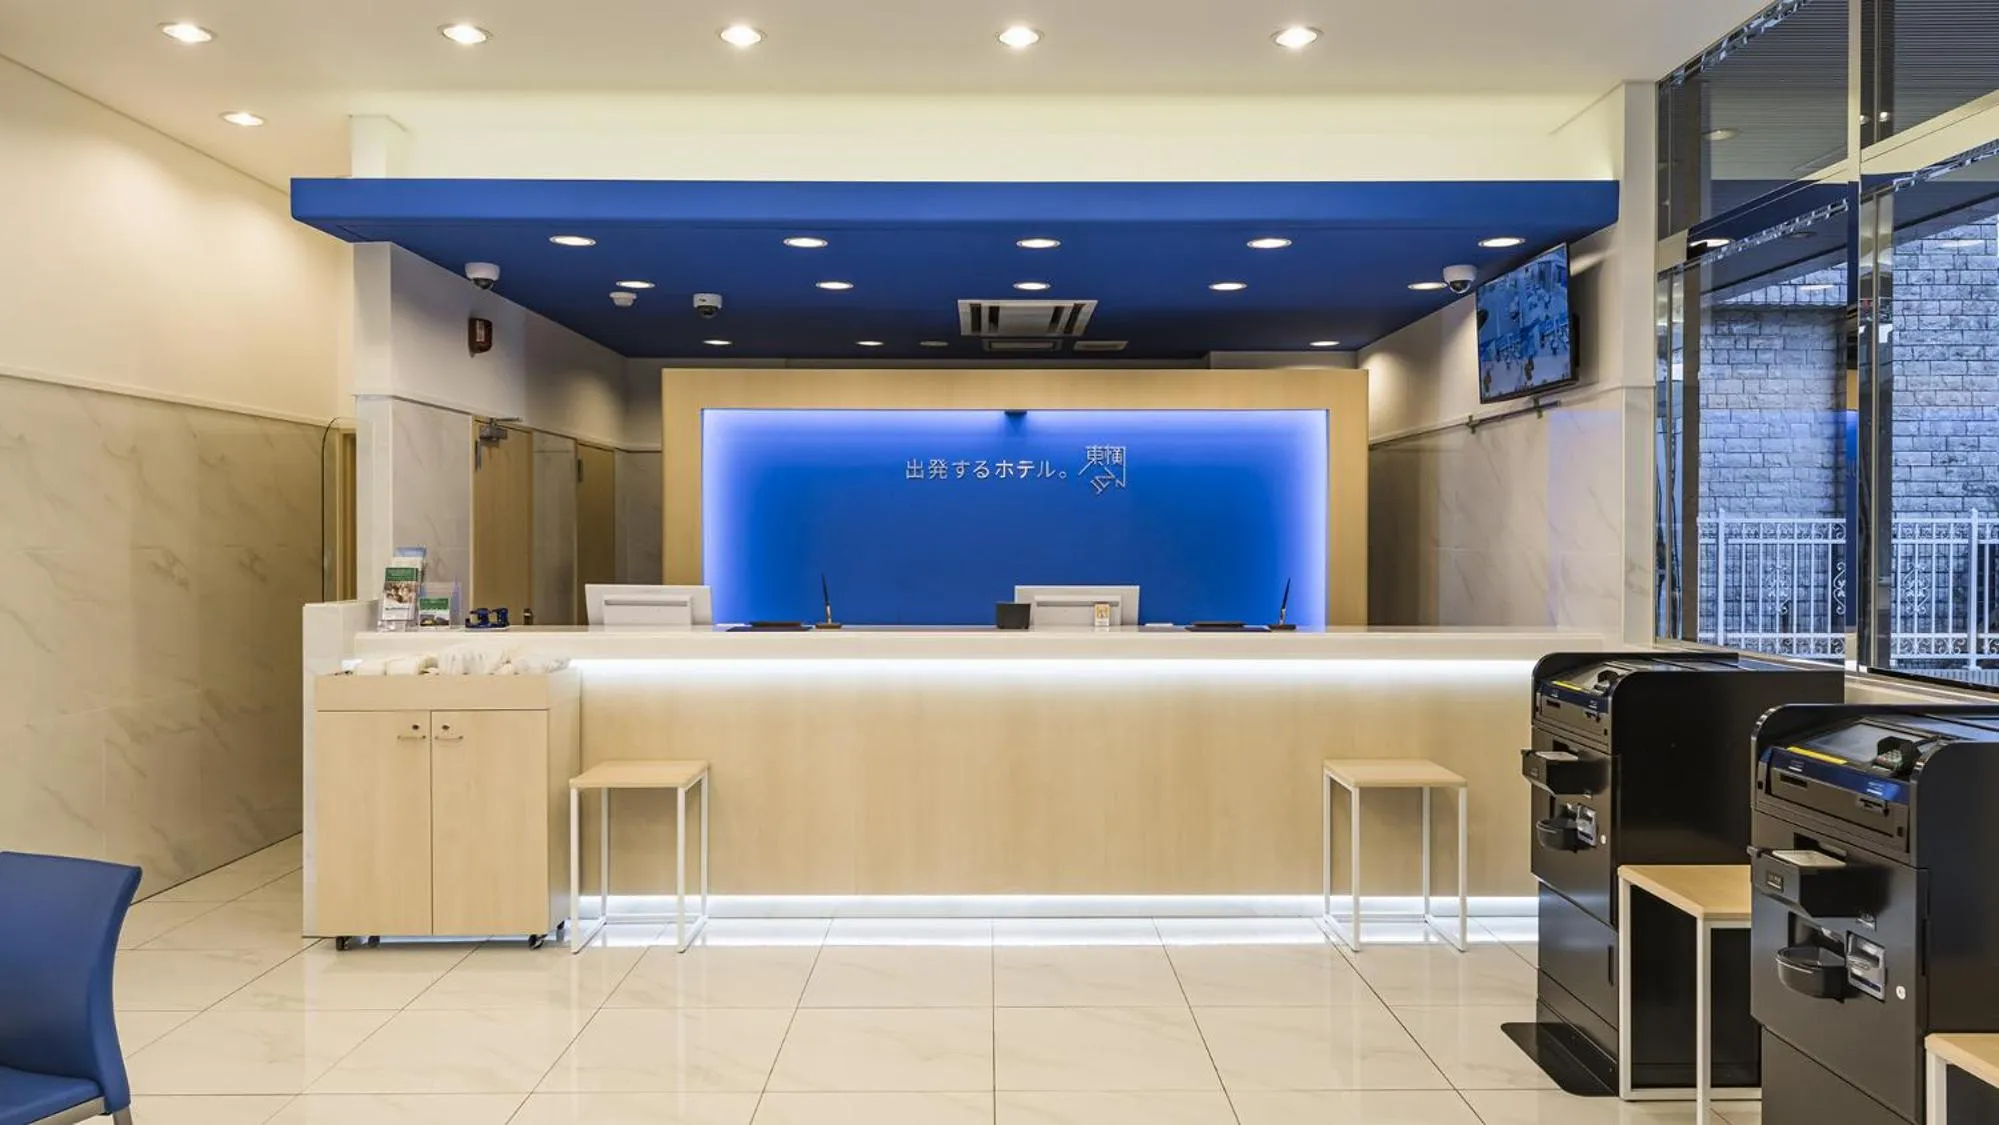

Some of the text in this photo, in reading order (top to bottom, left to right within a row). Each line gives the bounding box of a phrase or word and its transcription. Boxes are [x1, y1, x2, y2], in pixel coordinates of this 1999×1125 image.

[905, 458, 1068, 480] 出発するホテル。
